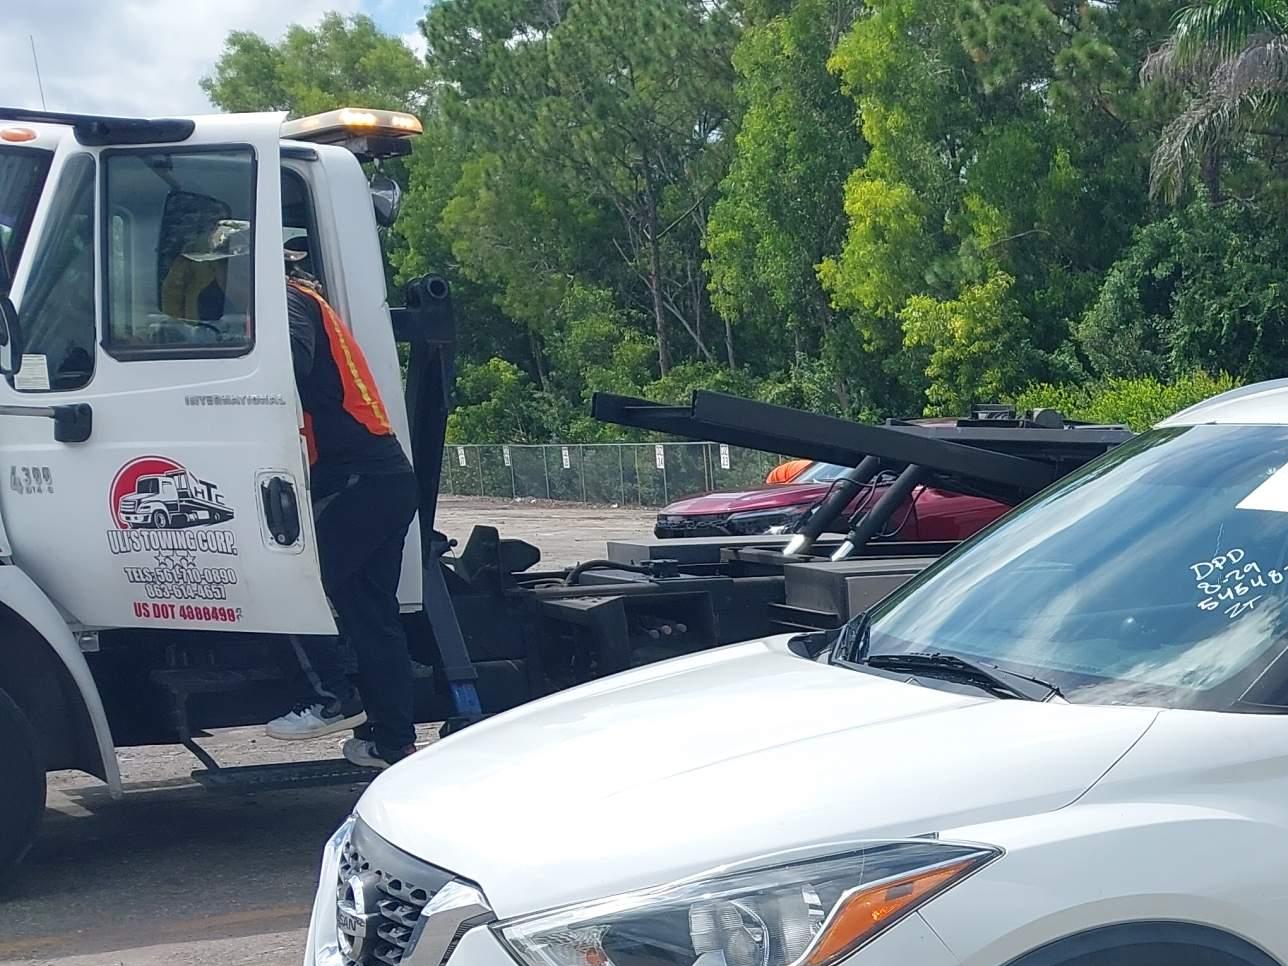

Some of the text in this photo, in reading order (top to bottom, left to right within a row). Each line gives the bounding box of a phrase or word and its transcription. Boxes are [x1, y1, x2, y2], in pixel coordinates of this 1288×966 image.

[141, 529, 198, 551] TOWING
[197, 530, 238, 555] CORP.
[1190, 548, 1245, 581] DPD
[133, 602, 150, 618] US
[152, 603, 175, 619] DOT
